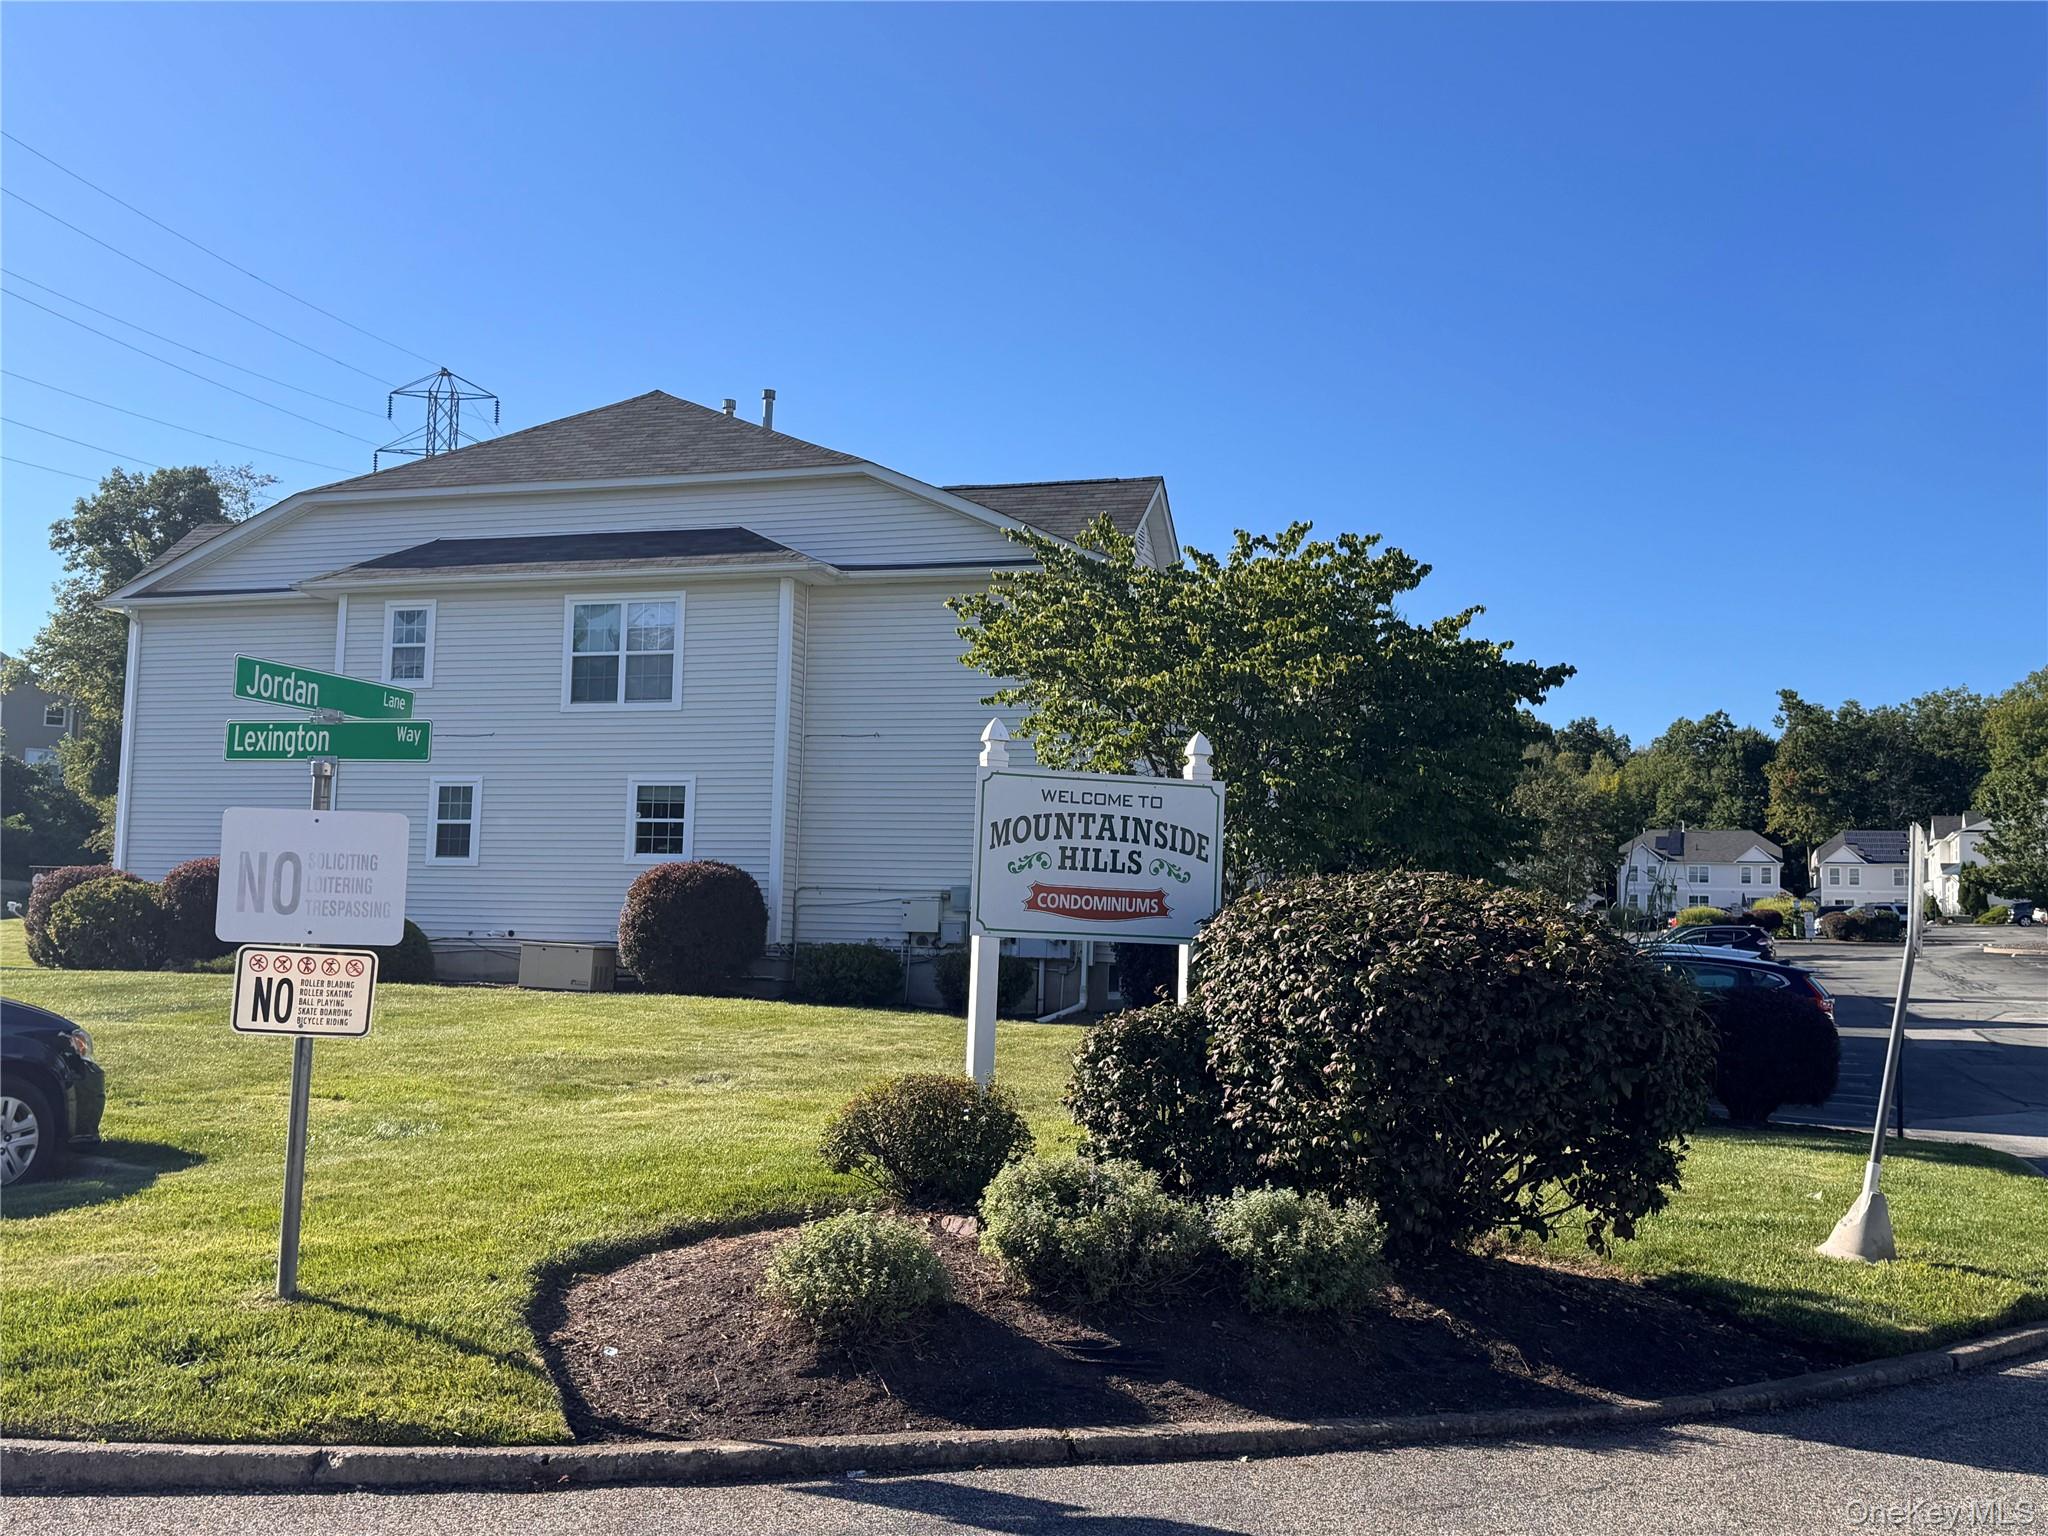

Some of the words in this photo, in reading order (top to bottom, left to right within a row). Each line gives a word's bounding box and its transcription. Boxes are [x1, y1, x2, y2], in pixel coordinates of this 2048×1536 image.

[246, 665, 319, 706] Jordan
[383, 691, 406, 710] Lane
[233, 724, 330, 758] Lexington
[396, 726, 422, 745] Way
[1041, 788, 1133, 808] WELCOME
[1138, 795, 1163, 809] TO
[989, 812, 1210, 863] MOUNTAINSIDE
[308, 853, 379, 871] SOLICITING
[1057, 845, 1143, 875] HILLS
[236, 851, 302, 916] NO
[306, 876, 373, 895] LOITERING
[305, 899, 391, 918] TRESPASSING
[1037, 892, 1159, 914] CONDOMINIUMS
[299, 988, 324, 997] ROLLER
[326, 989, 353, 998] SKATING
[300, 978, 325, 988] ROLLER
[326, 980, 355, 989] BLADING
[251, 976, 294, 1024] NO
[298, 997, 314, 1006] BALL
[316, 999, 345, 1007] PLAYING
[296, 1016, 323, 1025] BICYCLE
[325, 1017, 349, 1026] RIDING
[297, 1007, 318, 1016] SKATE
[319, 1008, 353, 1017] BOARDING
